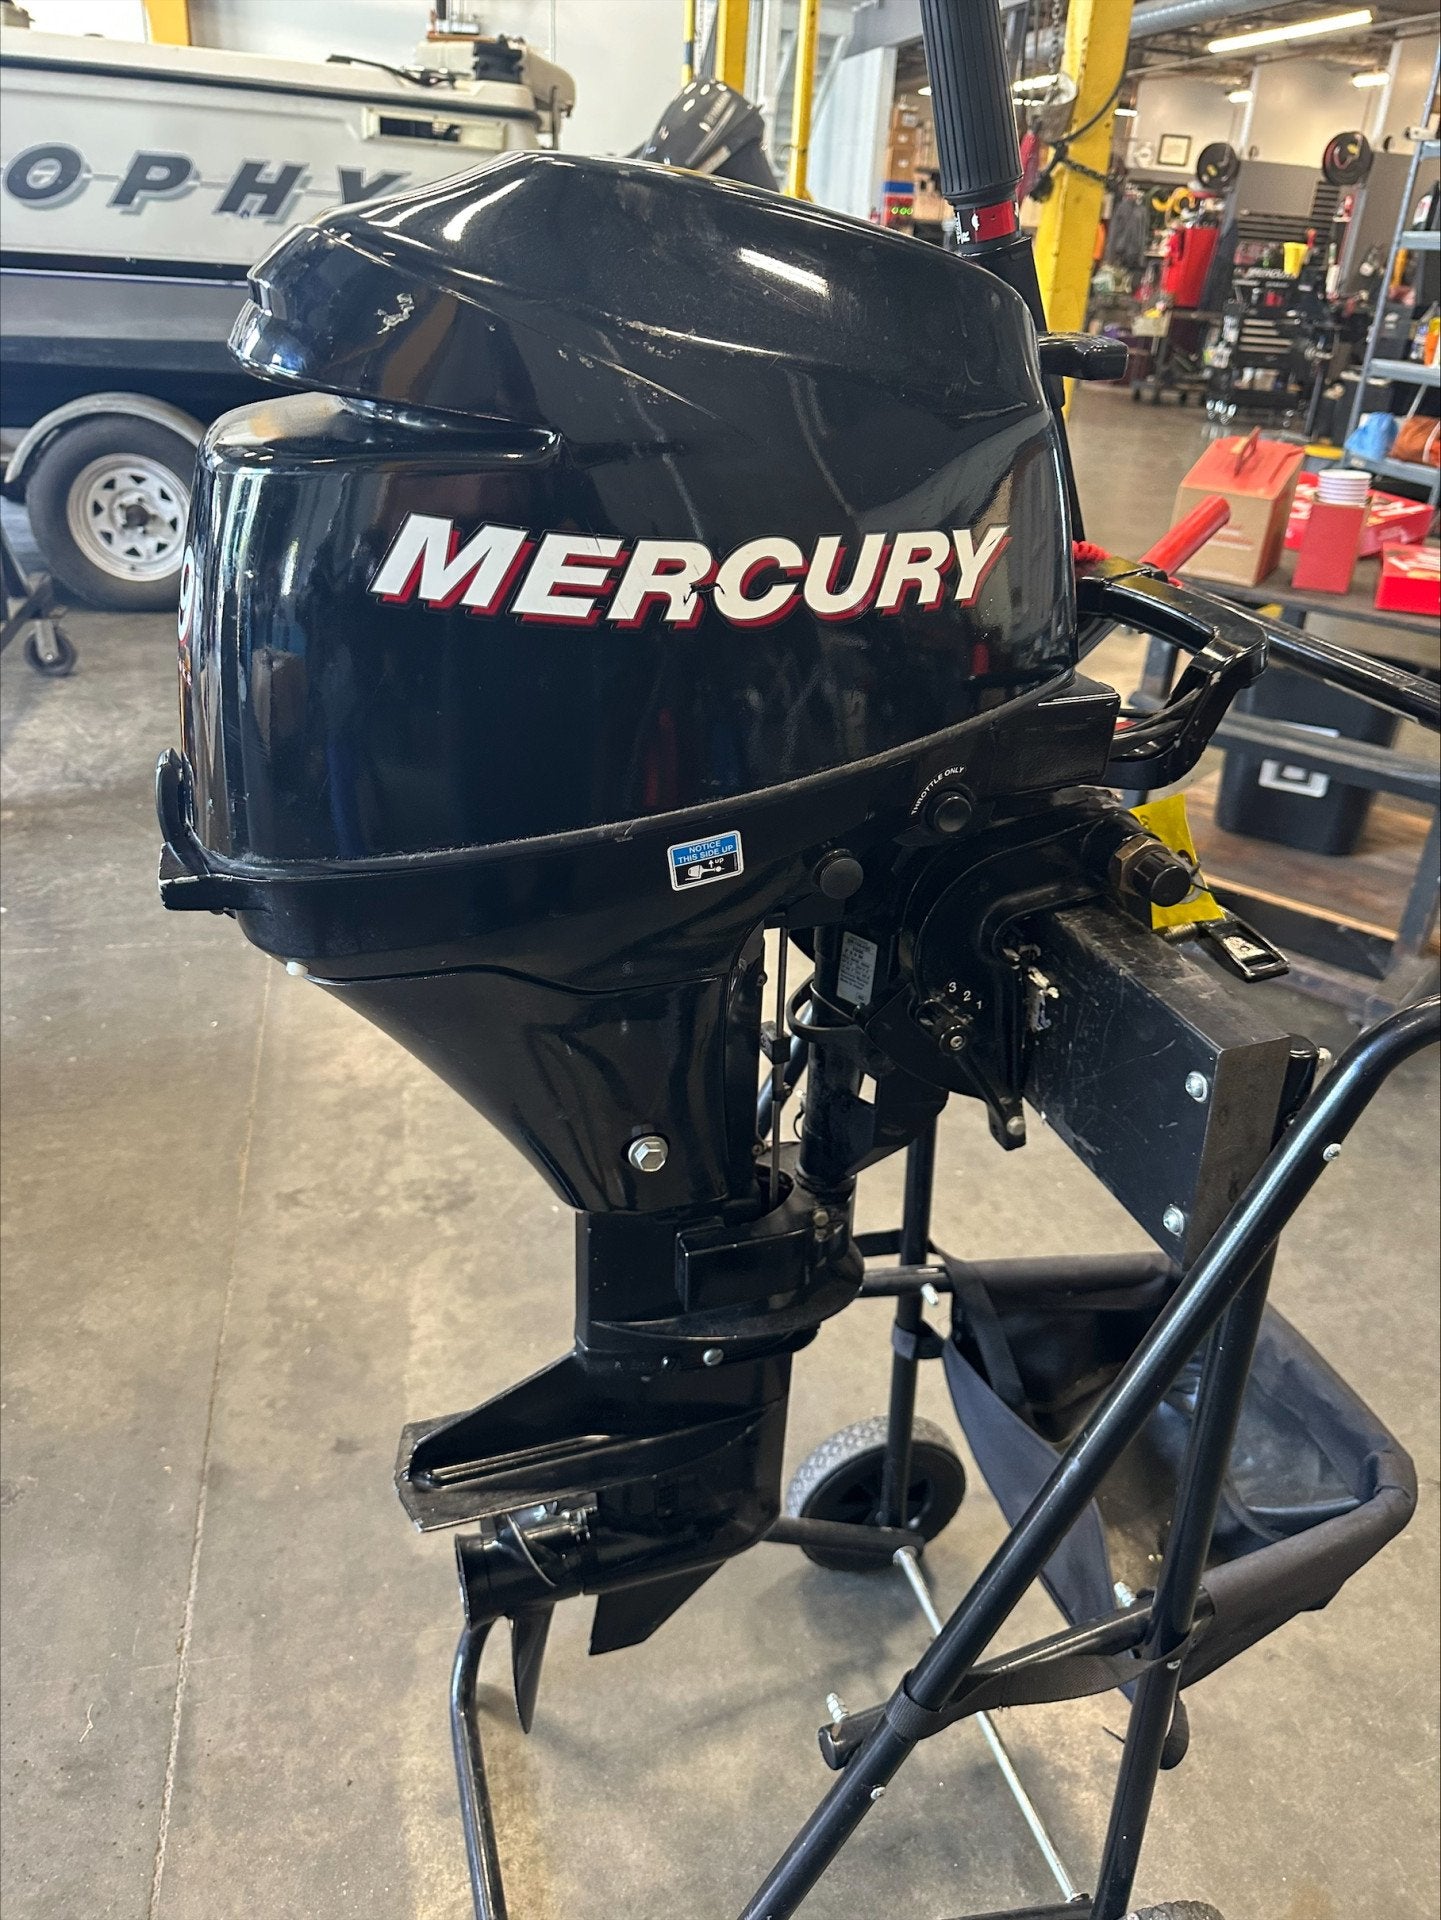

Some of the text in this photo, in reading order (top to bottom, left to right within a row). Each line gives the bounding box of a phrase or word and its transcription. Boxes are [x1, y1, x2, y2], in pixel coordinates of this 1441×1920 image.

[369, 511, 1010, 625] MERCURY
[911, 766, 965, 815] THROTTLE ONLY
[678, 844, 734, 864] THIS SIDE UP
[688, 840, 721, 854] NOTICE
[948, 981, 982, 1010] 3 2 1
